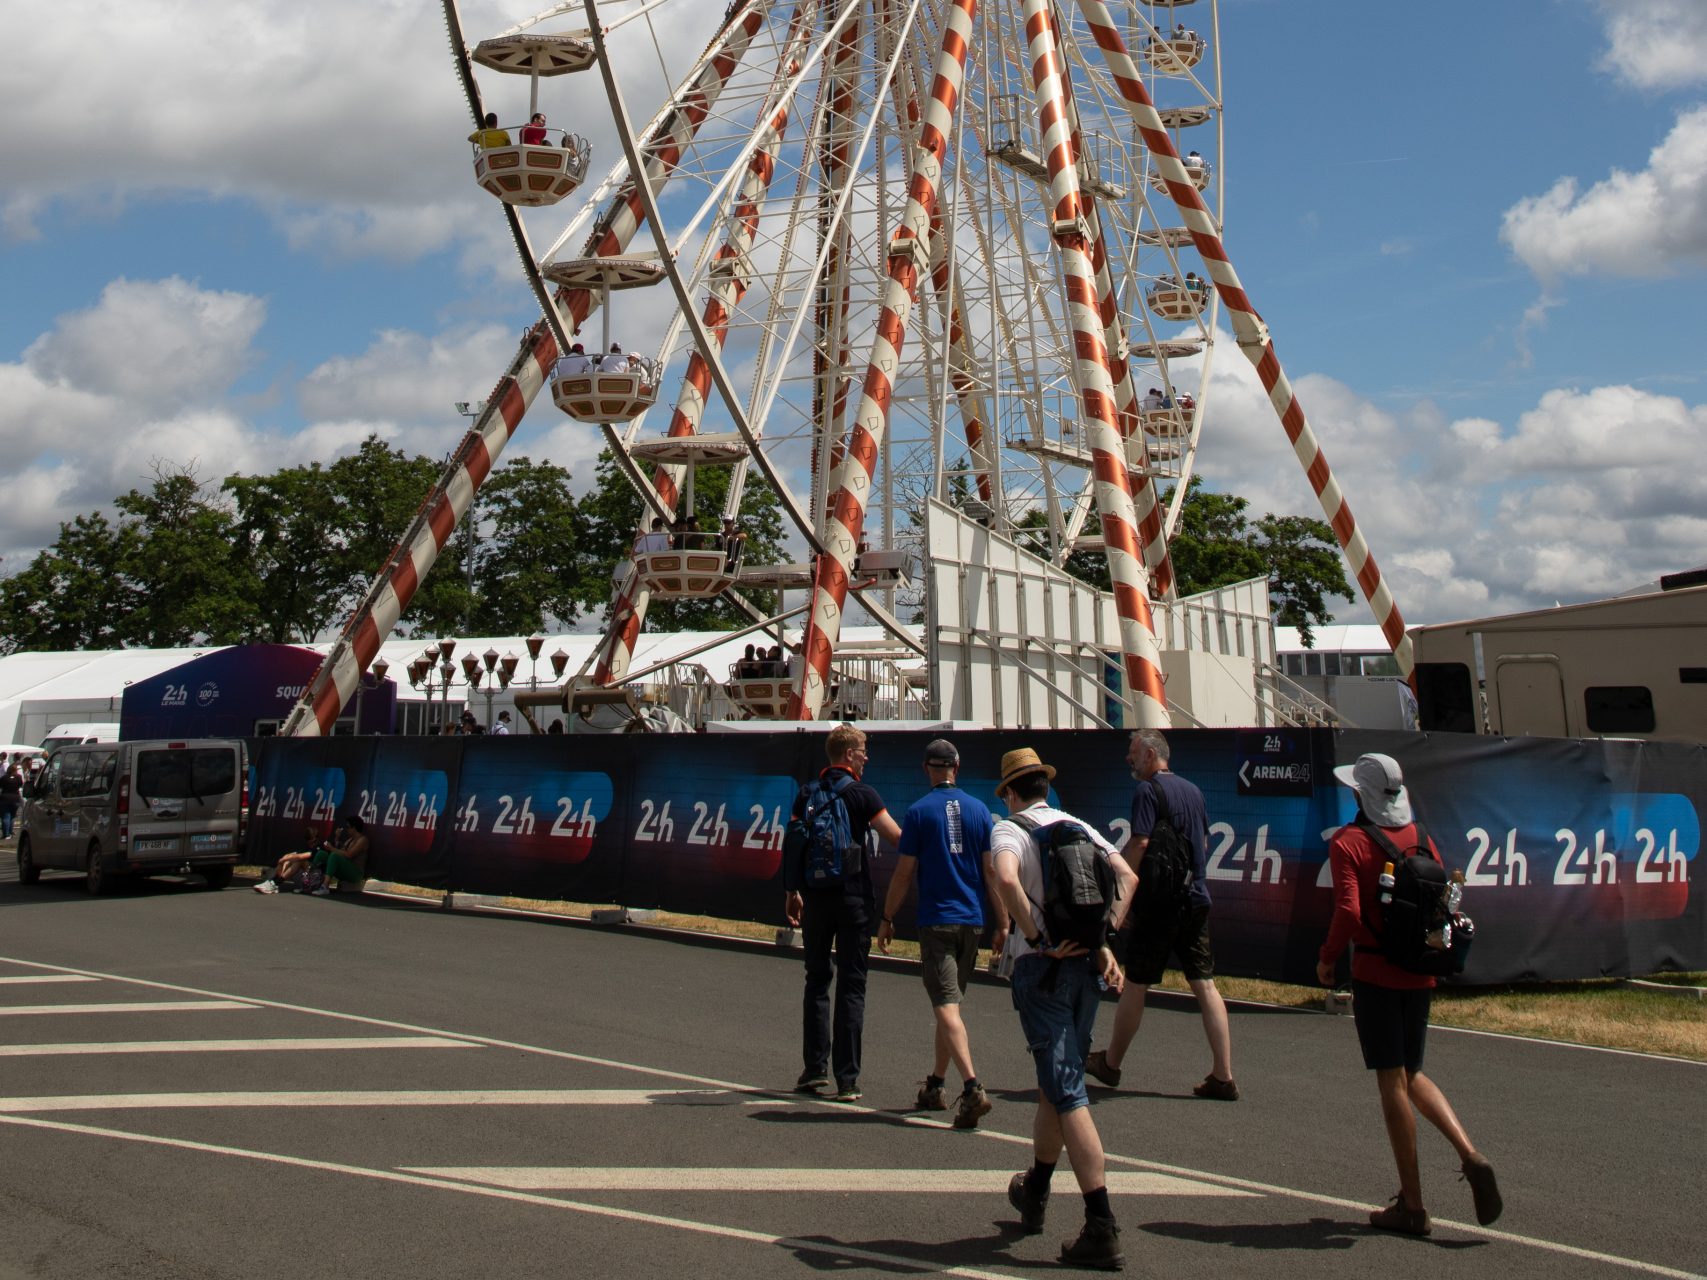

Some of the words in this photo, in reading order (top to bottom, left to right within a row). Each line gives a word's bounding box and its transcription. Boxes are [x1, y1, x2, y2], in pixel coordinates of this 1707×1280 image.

[163, 685, 188, 700] 24h
[199, 690, 212, 698] 100
[1264, 735, 1281, 748] 24h
[256, 786, 276, 817] 24h
[283, 787, 305, 819] 24h
[311, 788, 336, 821] 24h
[358, 790, 378, 824] 24h
[384, 792, 407, 827] 24h
[414, 793, 438, 830] 24h
[454, 795, 479, 832] 4h
[492, 795, 534, 835] 24h
[550, 797, 595, 838] 24h
[635, 800, 673, 842] 24h
[687, 801, 728, 846] 24h
[742, 804, 784, 851] 24h
[1205, 821, 1282, 883] 24h
[1465, 827, 1528, 887] 24h
[1554, 828, 1617, 885] 24h
[1636, 828, 1686, 884] 24h
